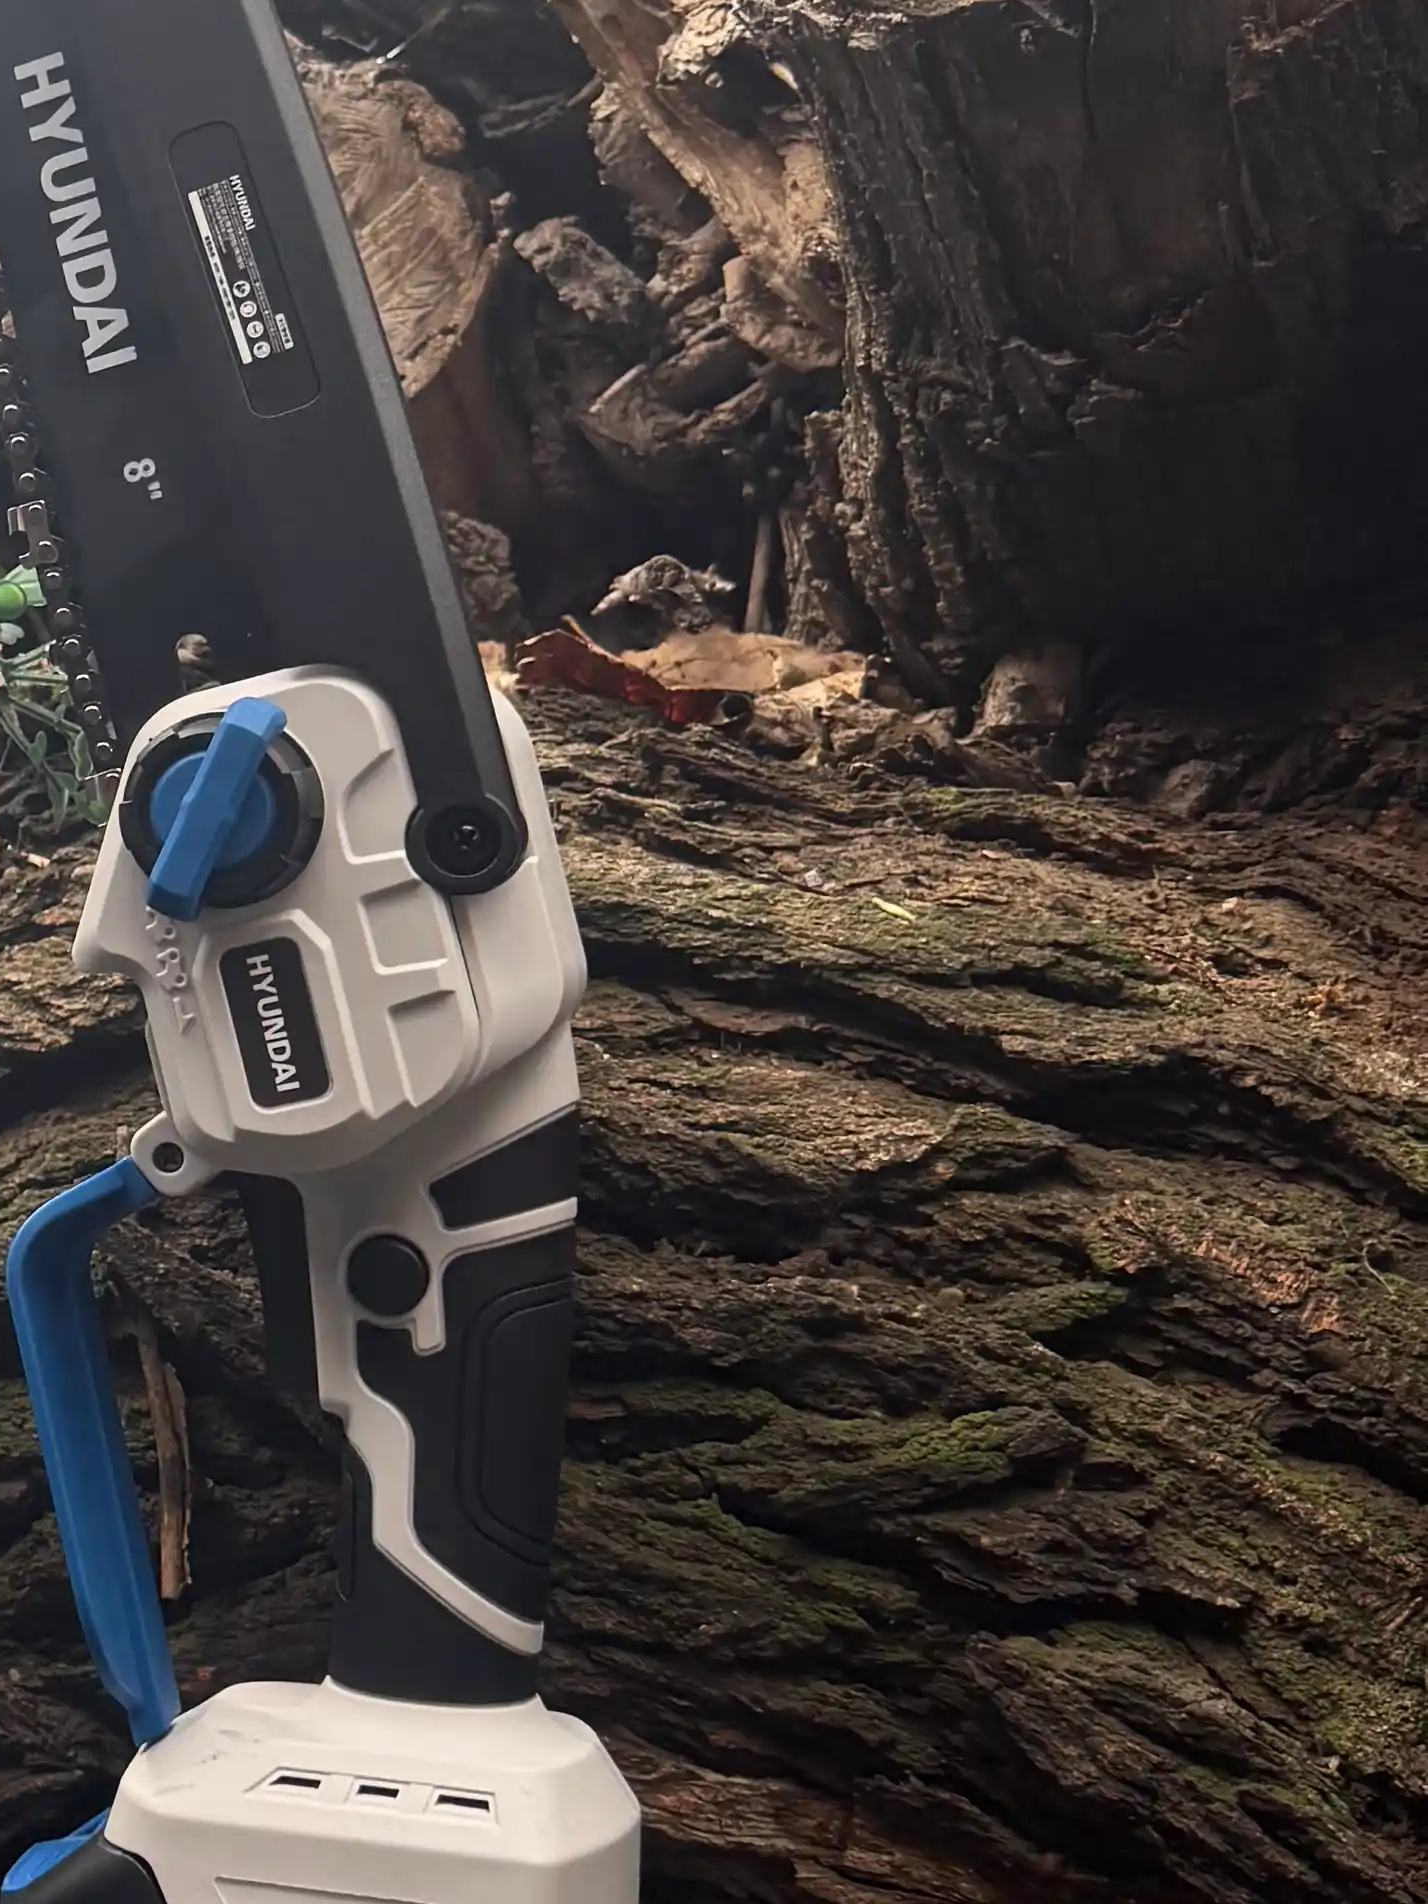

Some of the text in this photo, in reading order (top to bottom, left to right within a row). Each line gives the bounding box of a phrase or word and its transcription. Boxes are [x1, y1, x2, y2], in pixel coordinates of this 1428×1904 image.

[14, 51, 138, 374] HYUNDAI
[229, 174, 256, 232] HYUNDAI
[123, 457, 163, 500] 8"
[246, 954, 300, 1092] HYUNDAI
